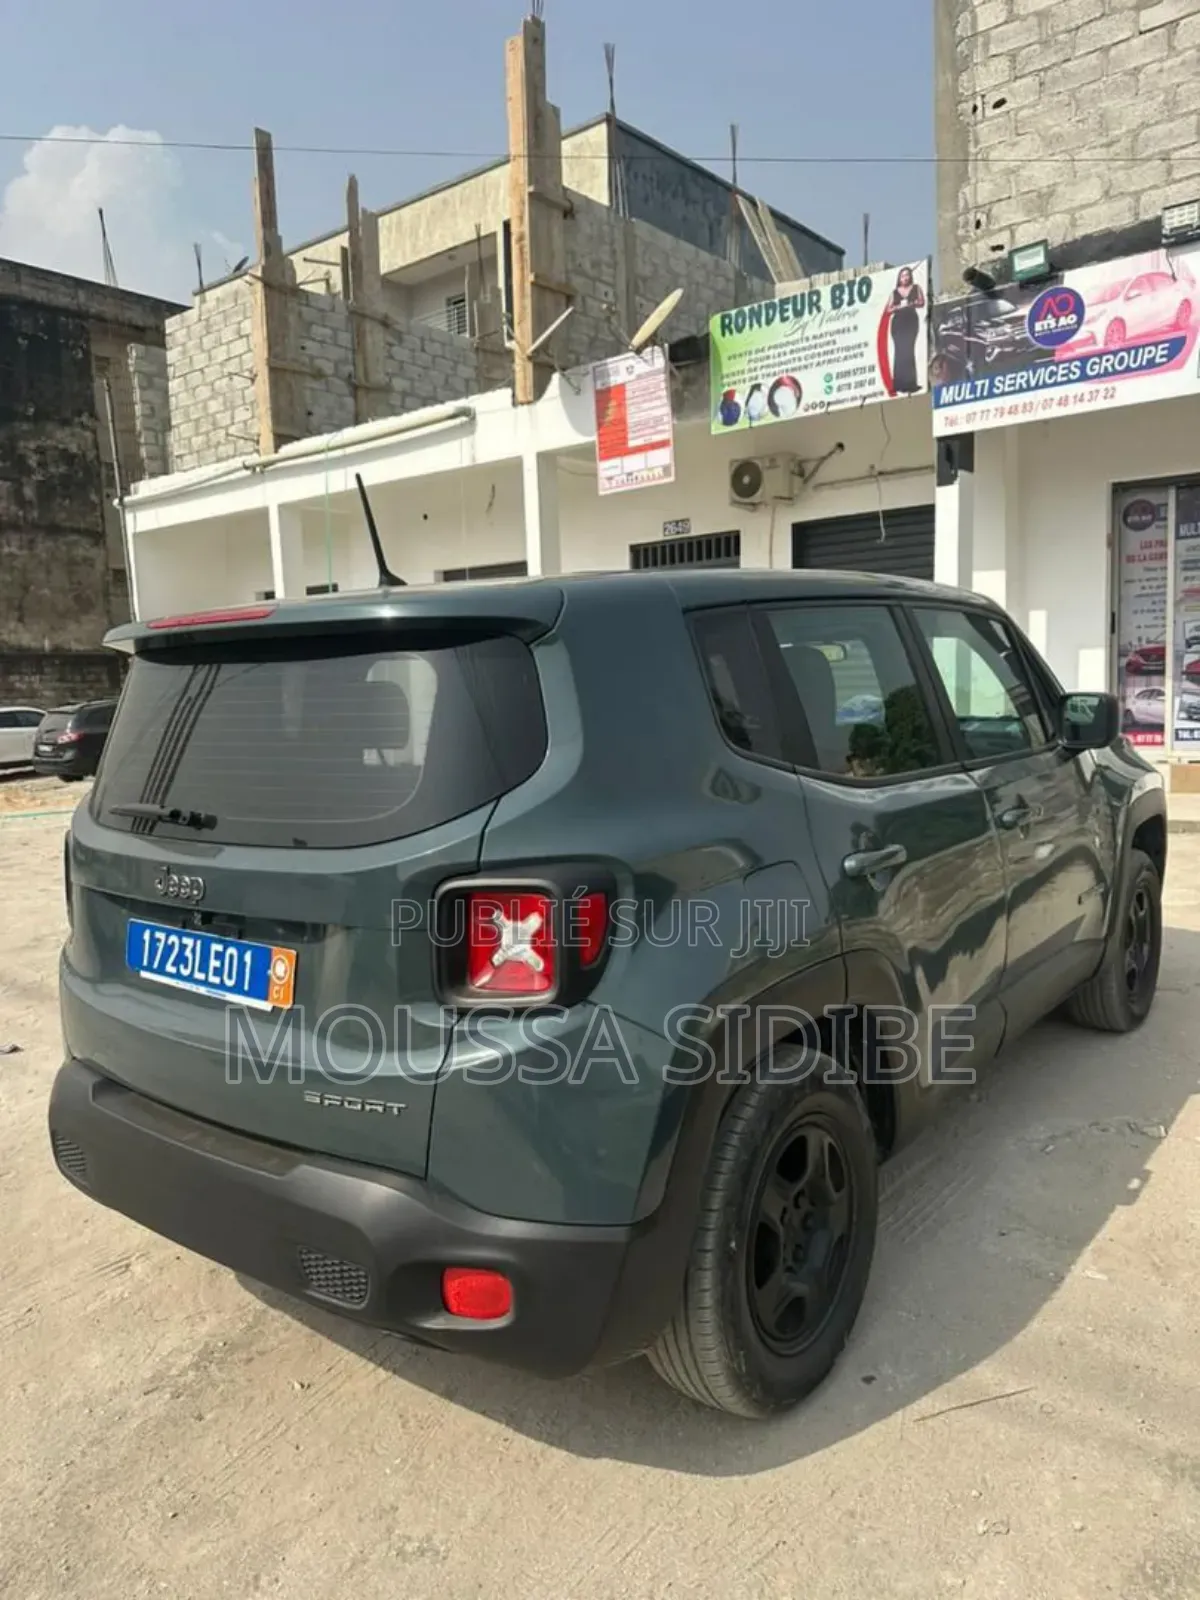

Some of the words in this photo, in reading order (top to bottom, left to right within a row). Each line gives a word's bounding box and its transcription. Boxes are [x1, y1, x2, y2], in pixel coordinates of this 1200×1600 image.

[720, 289, 821, 338] RONDEUR
[831, 276, 872, 310] BIO
[1058, 313, 1078, 327] AO
[727, 349, 753, 361] VENTE
[755, 345, 766, 355] DE
[767, 335, 810, 351] PRODUITS
[940, 379, 989, 405] MULTI
[993, 358, 1080, 394] SERVICES
[1086, 343, 1170, 377] GROUPE
[965, 411, 977, 424] 07
[980, 409, 991, 421] 77
[1042, 397, 1054, 410] 07
[1073, 391, 1085, 405] 14
[1087, 389, 1100, 402] 37
[1103, 386, 1117, 400] 22
[155, 865, 205, 904] Jeep
[142, 928, 252, 991] 1723LE01
[303, 1090, 407, 1116] SPORT
